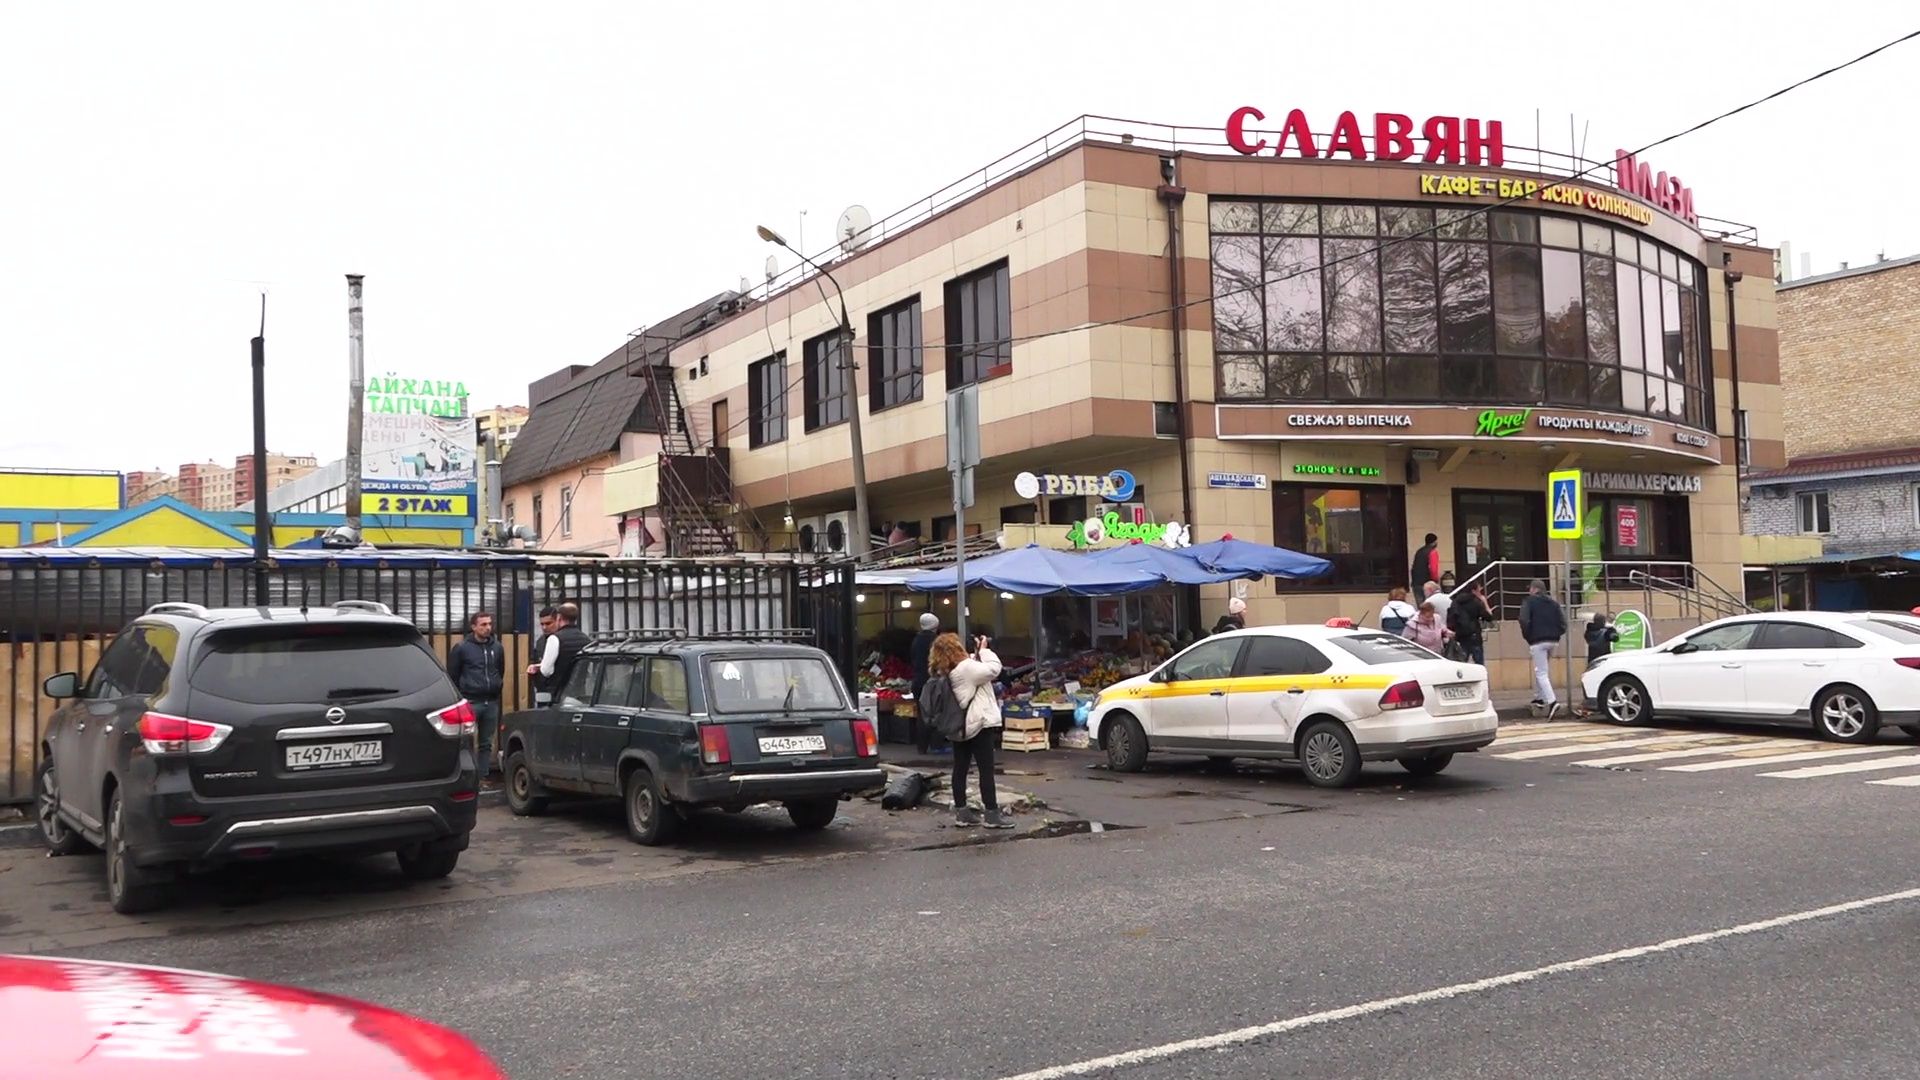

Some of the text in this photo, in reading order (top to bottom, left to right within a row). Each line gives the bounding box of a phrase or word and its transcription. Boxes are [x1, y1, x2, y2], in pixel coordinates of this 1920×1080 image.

[1226, 106, 1503, 167] СЛАВЯН
[1616, 149, 1700, 228] ПЛАЗА
[1587, 191, 1653, 226] СОЛНЫШКО
[367, 372, 469, 398] АЙХАНА
[367, 396, 461, 417] ТАПЧАН
[1288, 414, 1412, 427] СВЕЖАЯ ВЫПЕЧКА
[1475, 408, 1532, 437] Ярче!
[1538, 415, 1593, 430] ПРОДУКТЫ
[1043, 474, 1119, 496] РЫБА
[1583, 472, 1702, 492] ПАРИКМАХЕРСКАЯ
[378, 498, 452, 513] 2 ЭТАЖ
